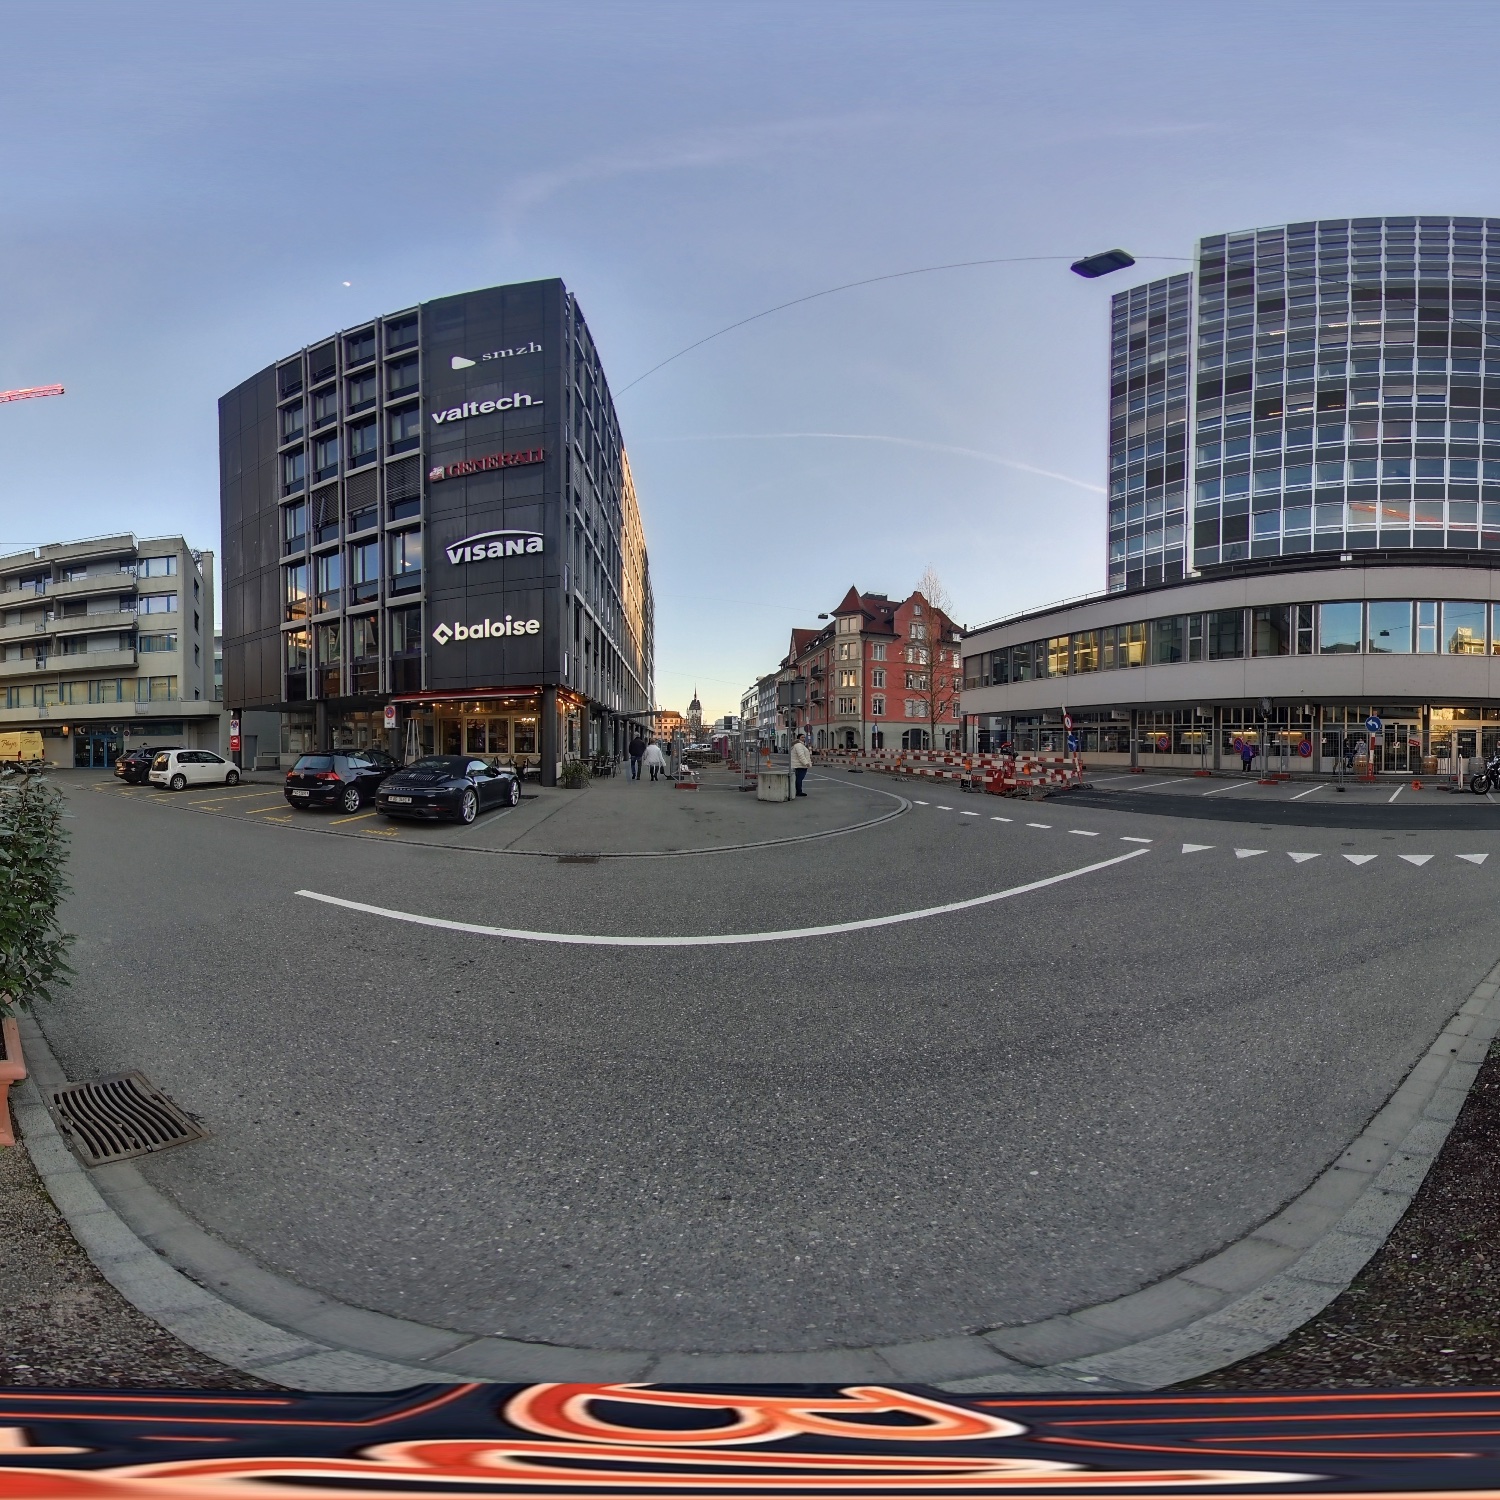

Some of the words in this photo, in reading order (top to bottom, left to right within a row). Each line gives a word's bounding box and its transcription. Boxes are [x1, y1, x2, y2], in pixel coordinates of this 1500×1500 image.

[482, 342, 543, 361] smzh
[445, 447, 545, 477] GENERALI
[454, 614, 540, 641] baloise
